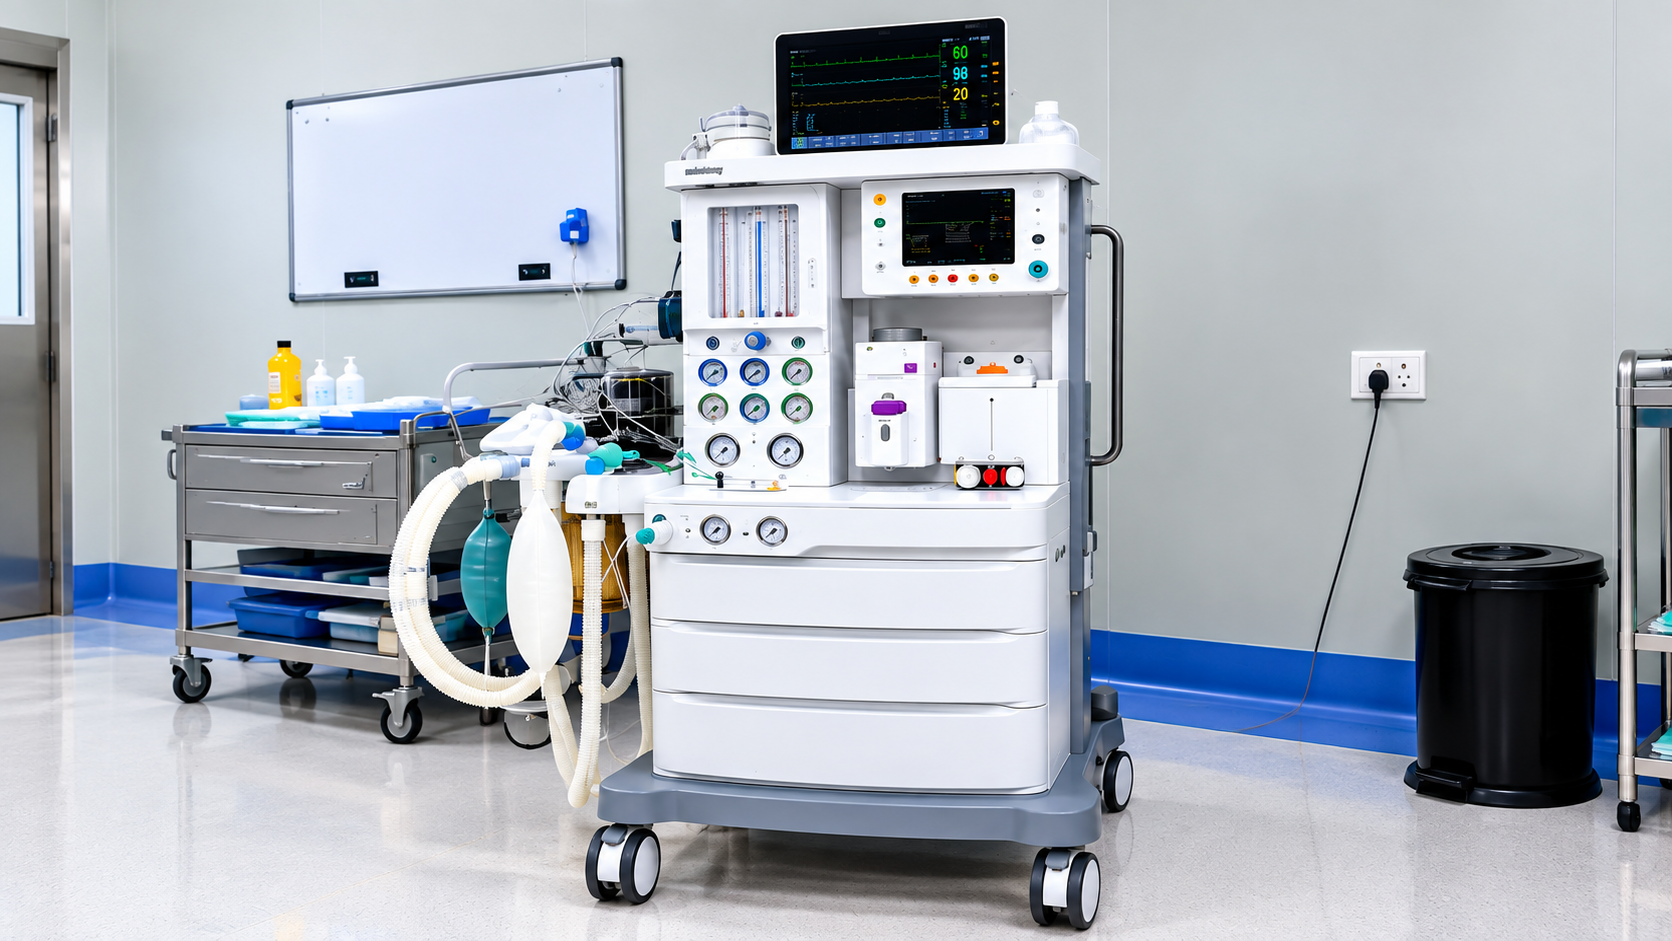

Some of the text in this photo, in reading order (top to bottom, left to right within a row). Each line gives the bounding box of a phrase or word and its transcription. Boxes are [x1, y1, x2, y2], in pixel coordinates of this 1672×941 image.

[953, 45, 968, 59] 60
[953, 66, 968, 80] 98
[953, 87, 968, 100] 20
